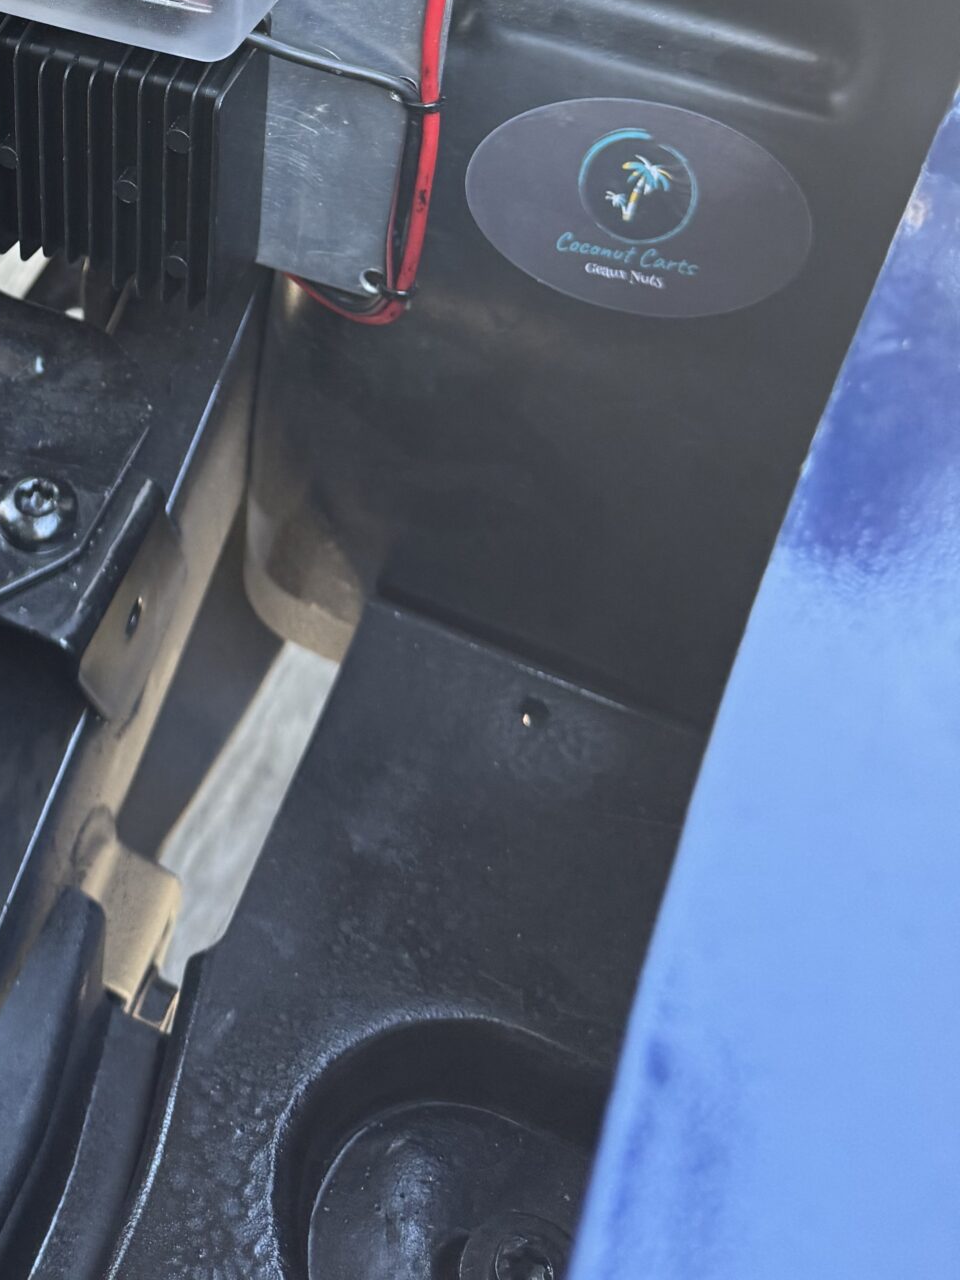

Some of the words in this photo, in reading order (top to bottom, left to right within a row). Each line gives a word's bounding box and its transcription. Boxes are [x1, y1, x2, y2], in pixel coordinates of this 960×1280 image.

[556, 231, 636, 263] Coconut
[640, 248, 699, 275] Carts
[629, 270, 663, 288] Nuts
